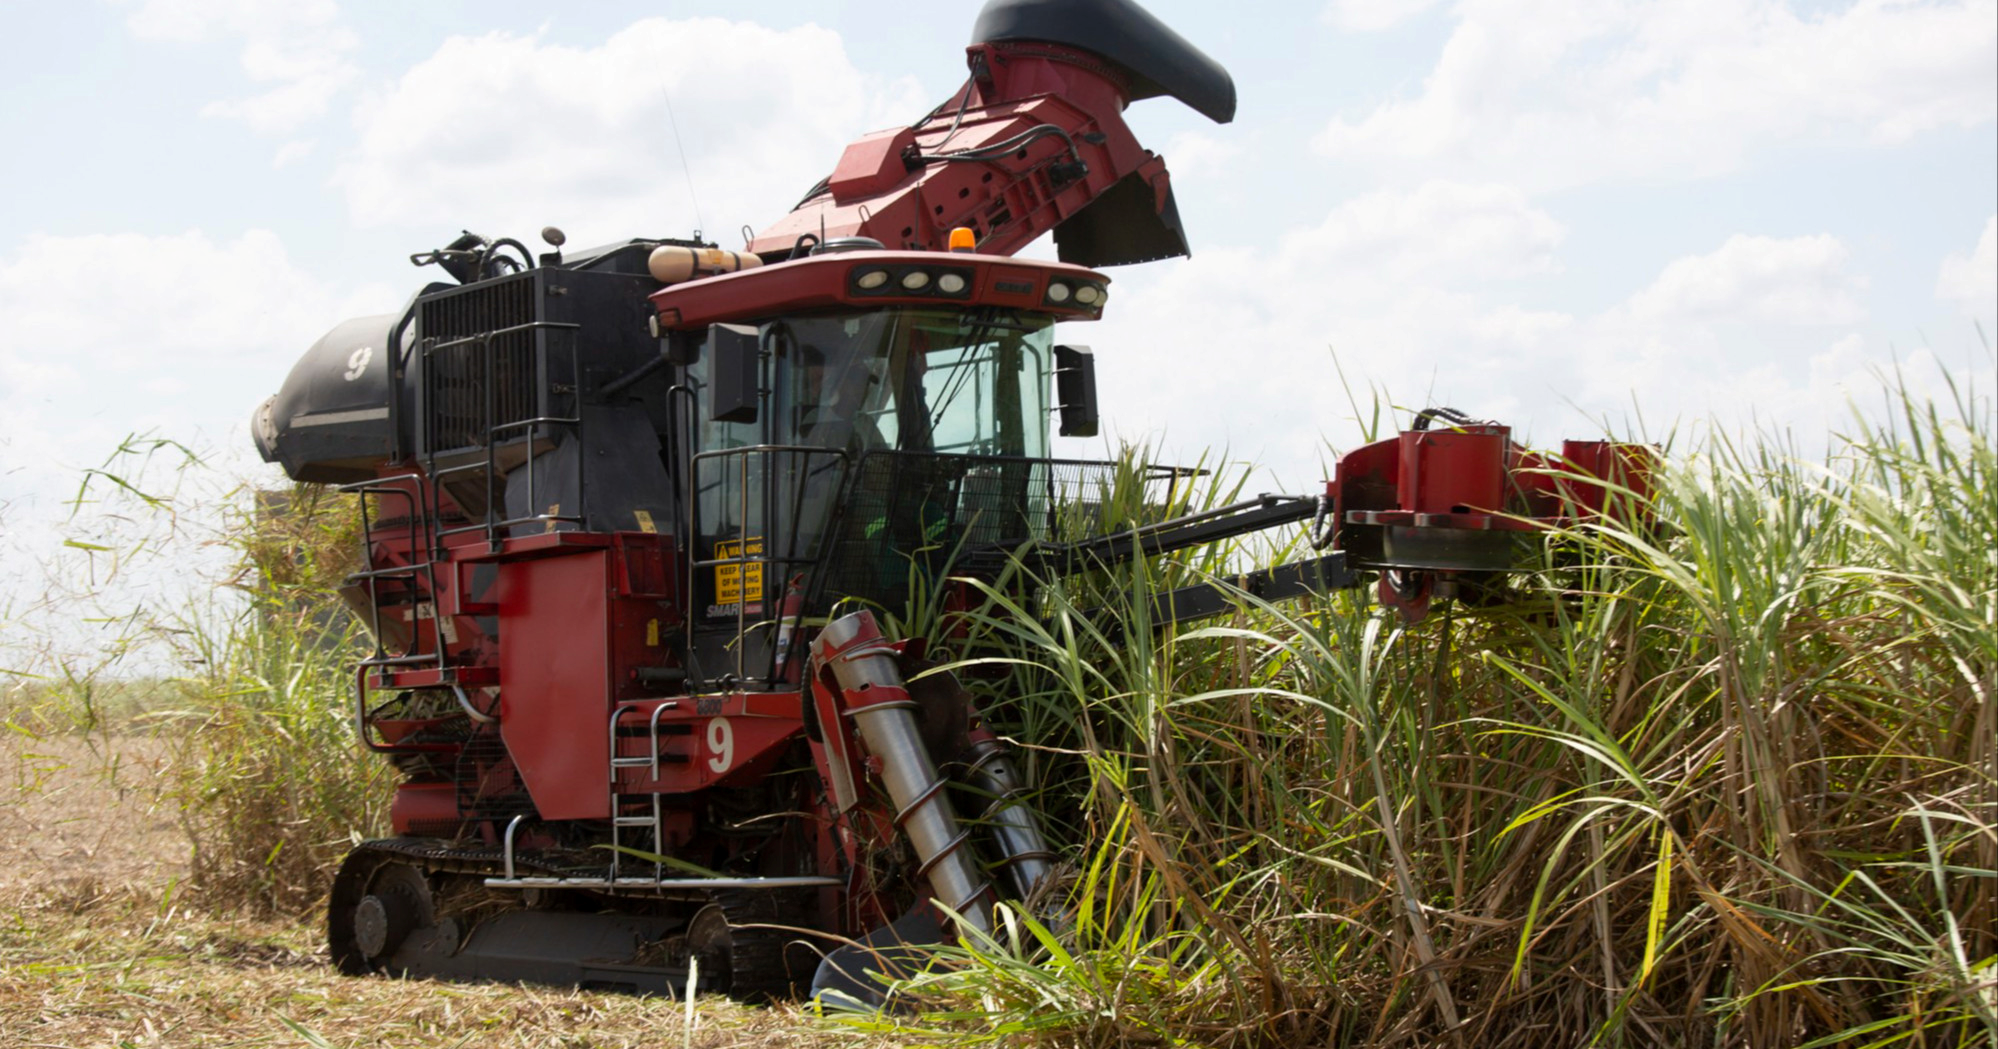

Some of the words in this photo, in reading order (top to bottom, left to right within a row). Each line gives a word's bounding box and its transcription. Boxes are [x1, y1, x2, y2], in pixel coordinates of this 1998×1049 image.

[344, 346, 373, 382] 9
[720, 566, 737, 575] KEEP
[722, 578, 731, 587] OF
[707, 717, 734, 773] 9
